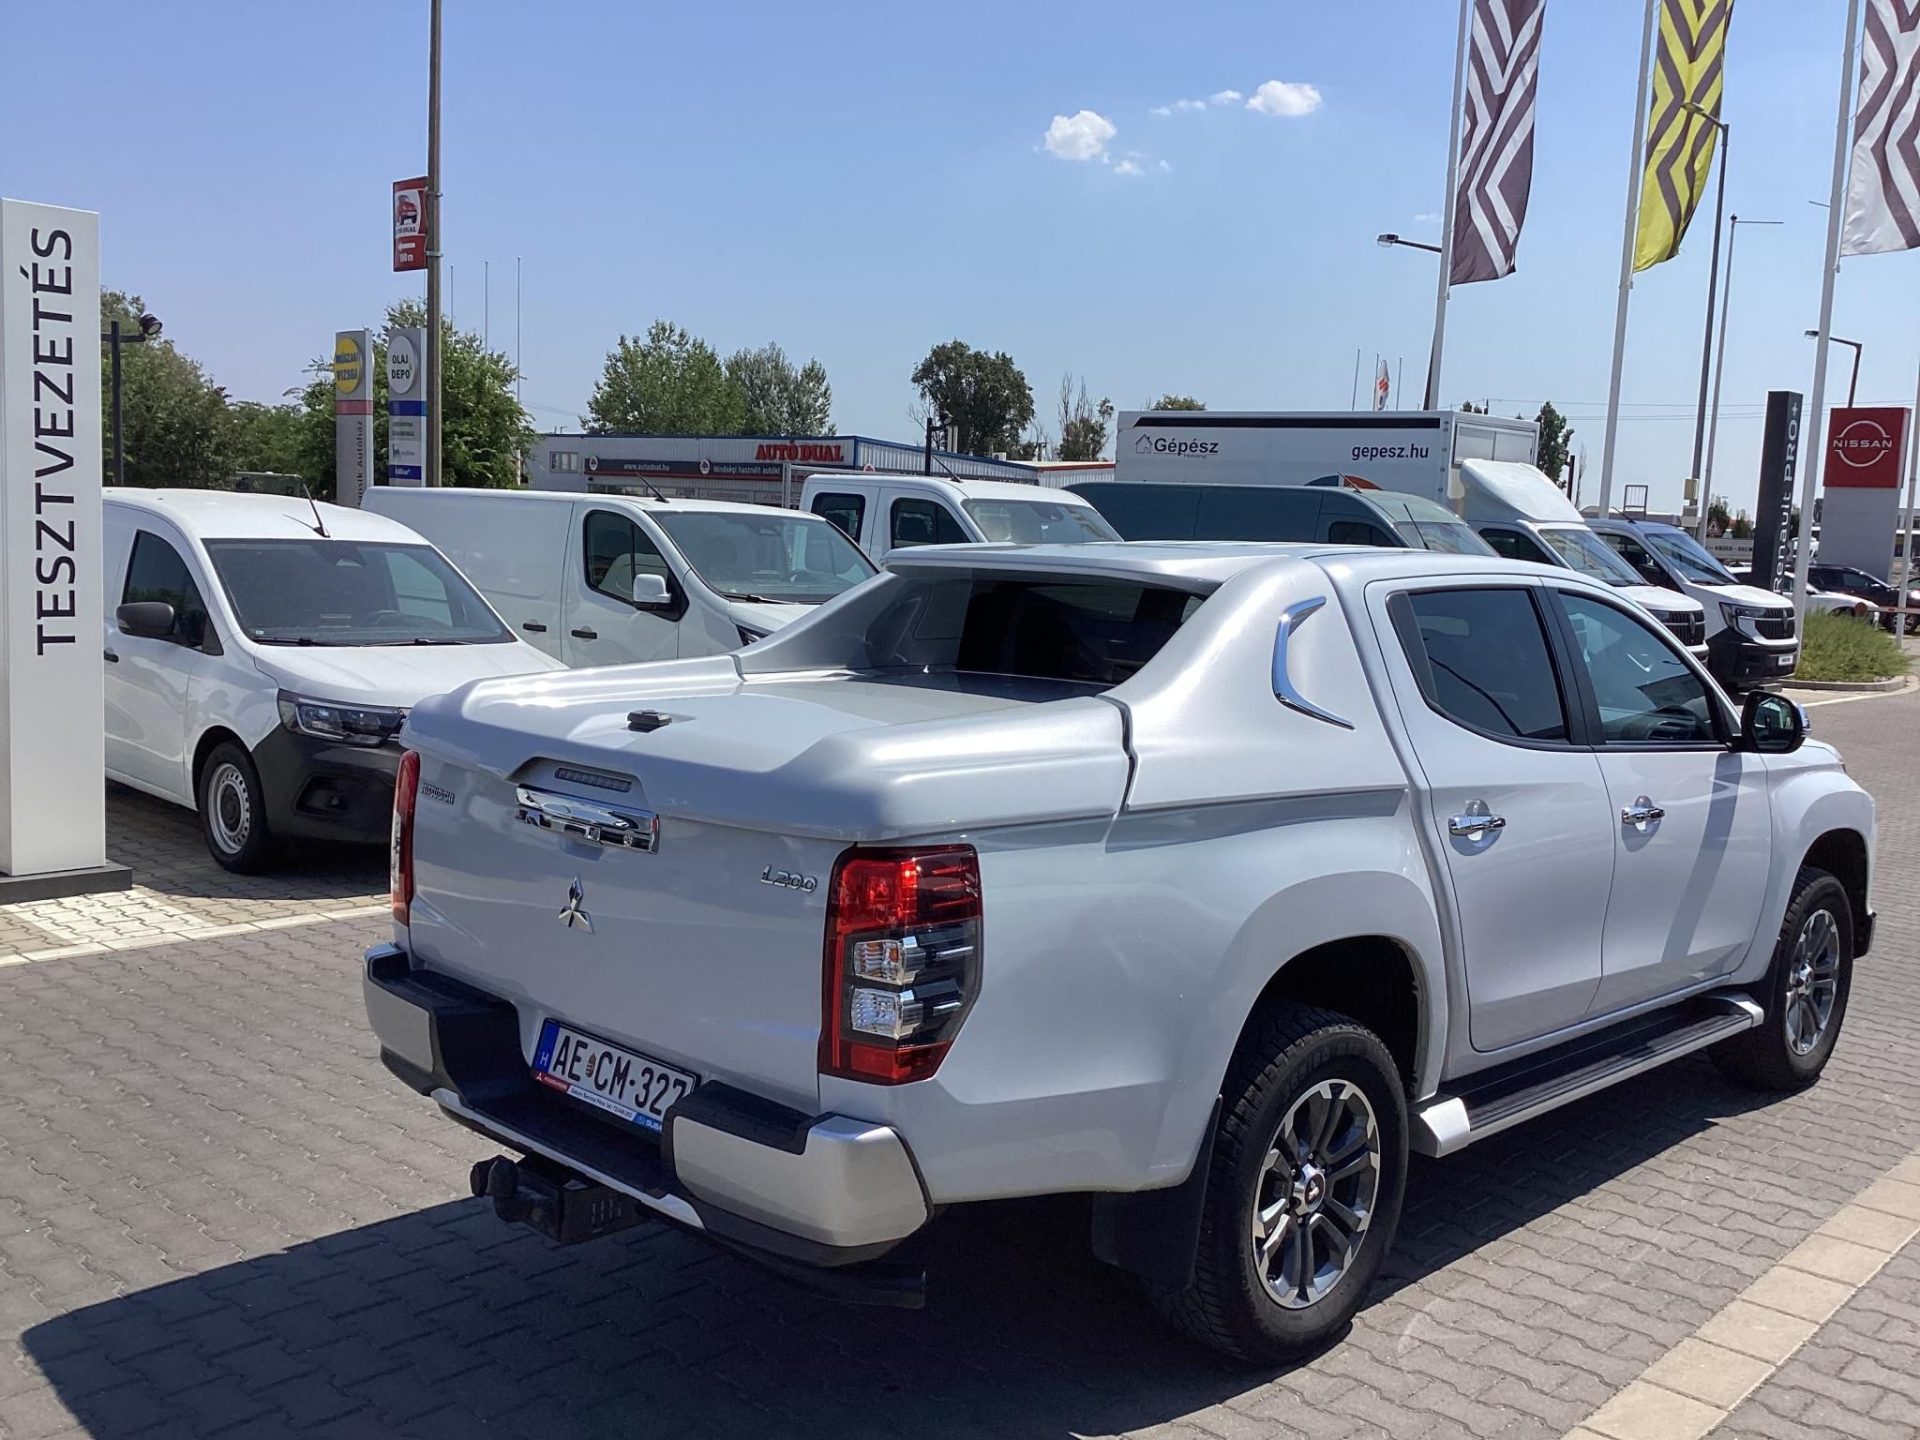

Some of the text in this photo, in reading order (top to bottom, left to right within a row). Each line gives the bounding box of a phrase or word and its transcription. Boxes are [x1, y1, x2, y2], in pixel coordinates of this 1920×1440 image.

[392, 353, 409, 365] OLAJ
[19, 228, 76, 656] TESZTVEZETÉS
[1153, 437, 1219, 456] Gépész
[1832, 439, 1893, 448] NISSAN
[800, 444, 844, 463] DUAL
[1352, 443, 1429, 461] gepesz.hu
[1773, 401, 1799, 593] Renault PRO+
[760, 864, 818, 894] L200
[539, 1051, 550, 1067] H
[552, 1035, 588, 1082] AE
